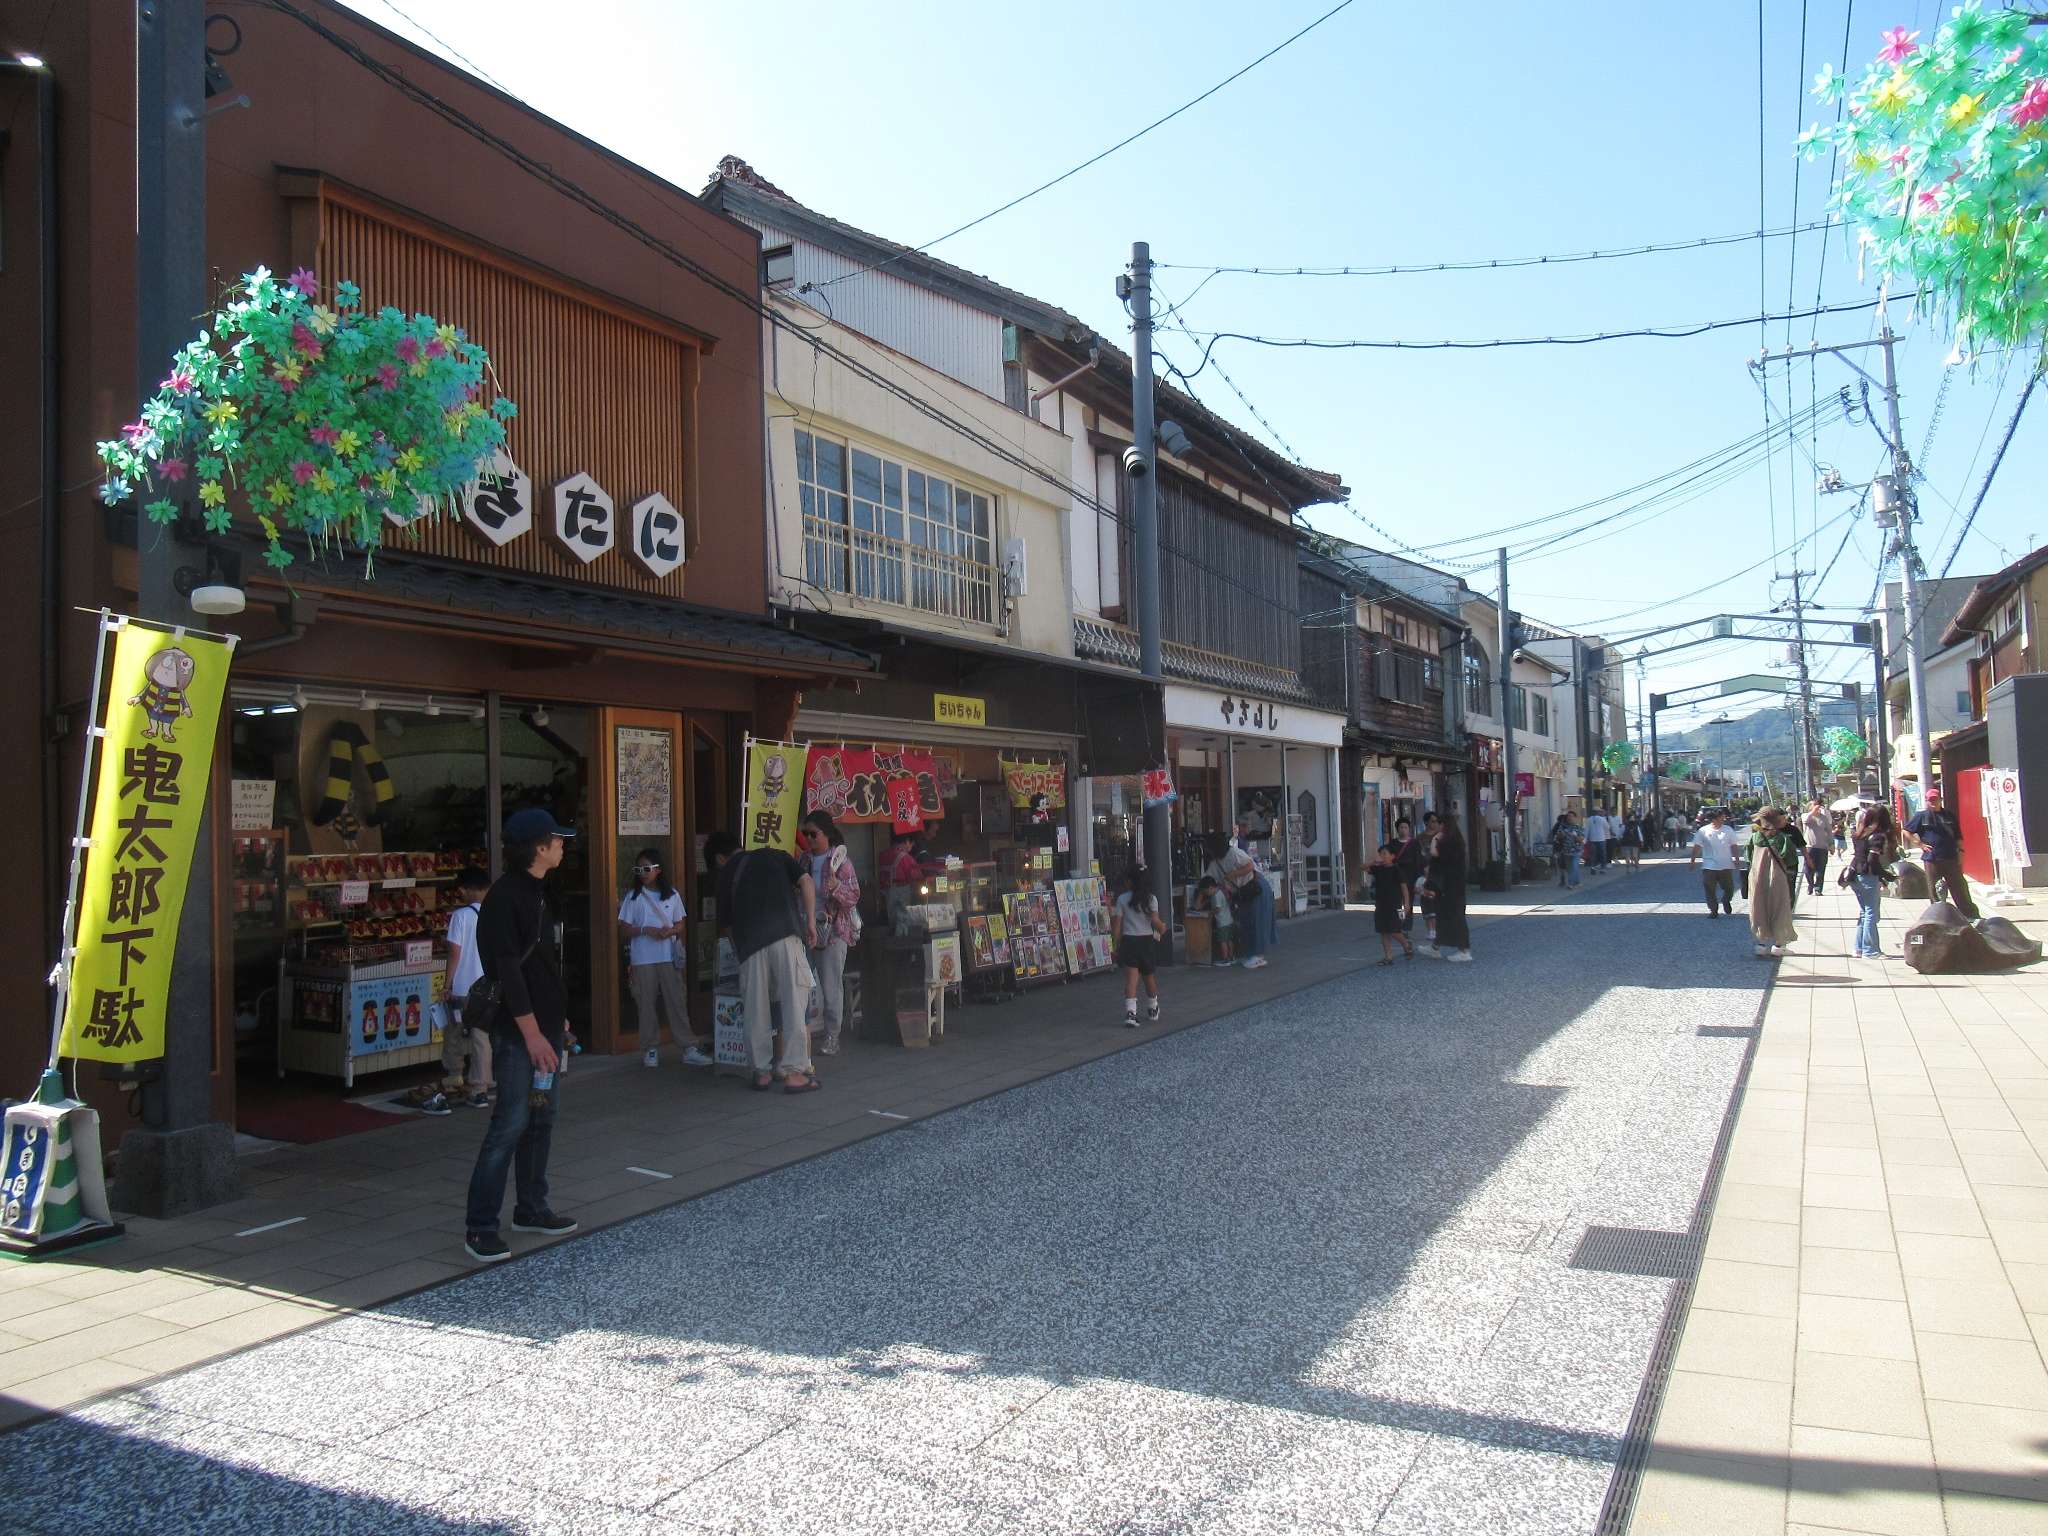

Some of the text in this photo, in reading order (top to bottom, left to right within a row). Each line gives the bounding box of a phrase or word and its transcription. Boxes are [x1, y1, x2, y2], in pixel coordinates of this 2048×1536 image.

[939, 701, 981, 720] ちいちゃん
[81, 742, 184, 1048] 鬼太郎下駄
